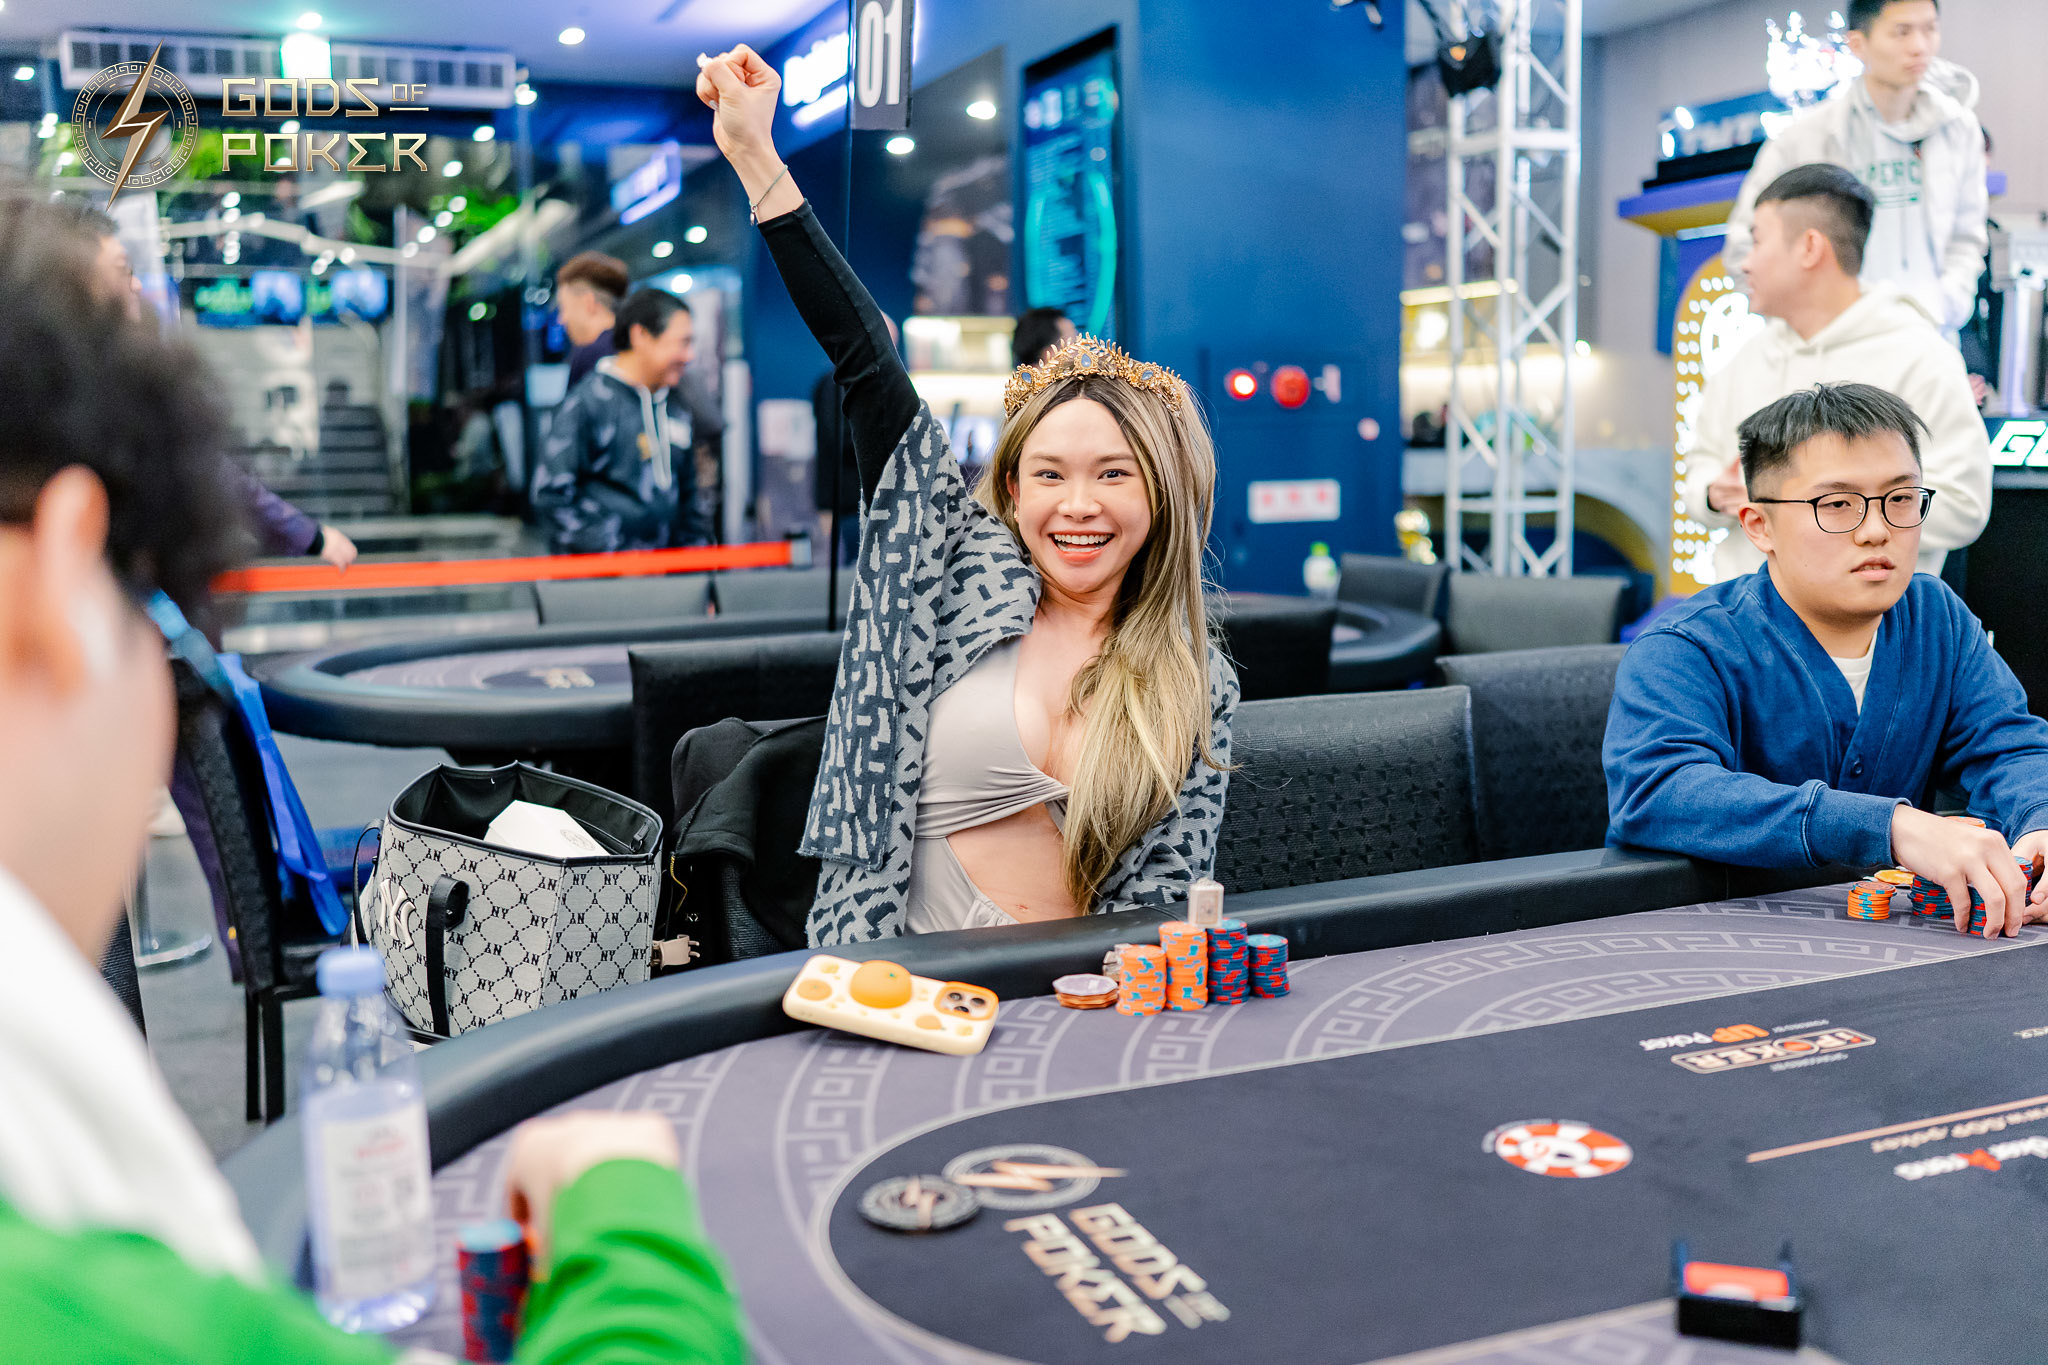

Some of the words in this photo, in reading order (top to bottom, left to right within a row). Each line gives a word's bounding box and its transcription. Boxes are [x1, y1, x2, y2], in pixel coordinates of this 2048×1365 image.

[857, 0, 902, 107] 01
[379, 878, 416, 950] NY
[1003, 1213, 1167, 1343] POKER
[1069, 1202, 1208, 1300] GODS
